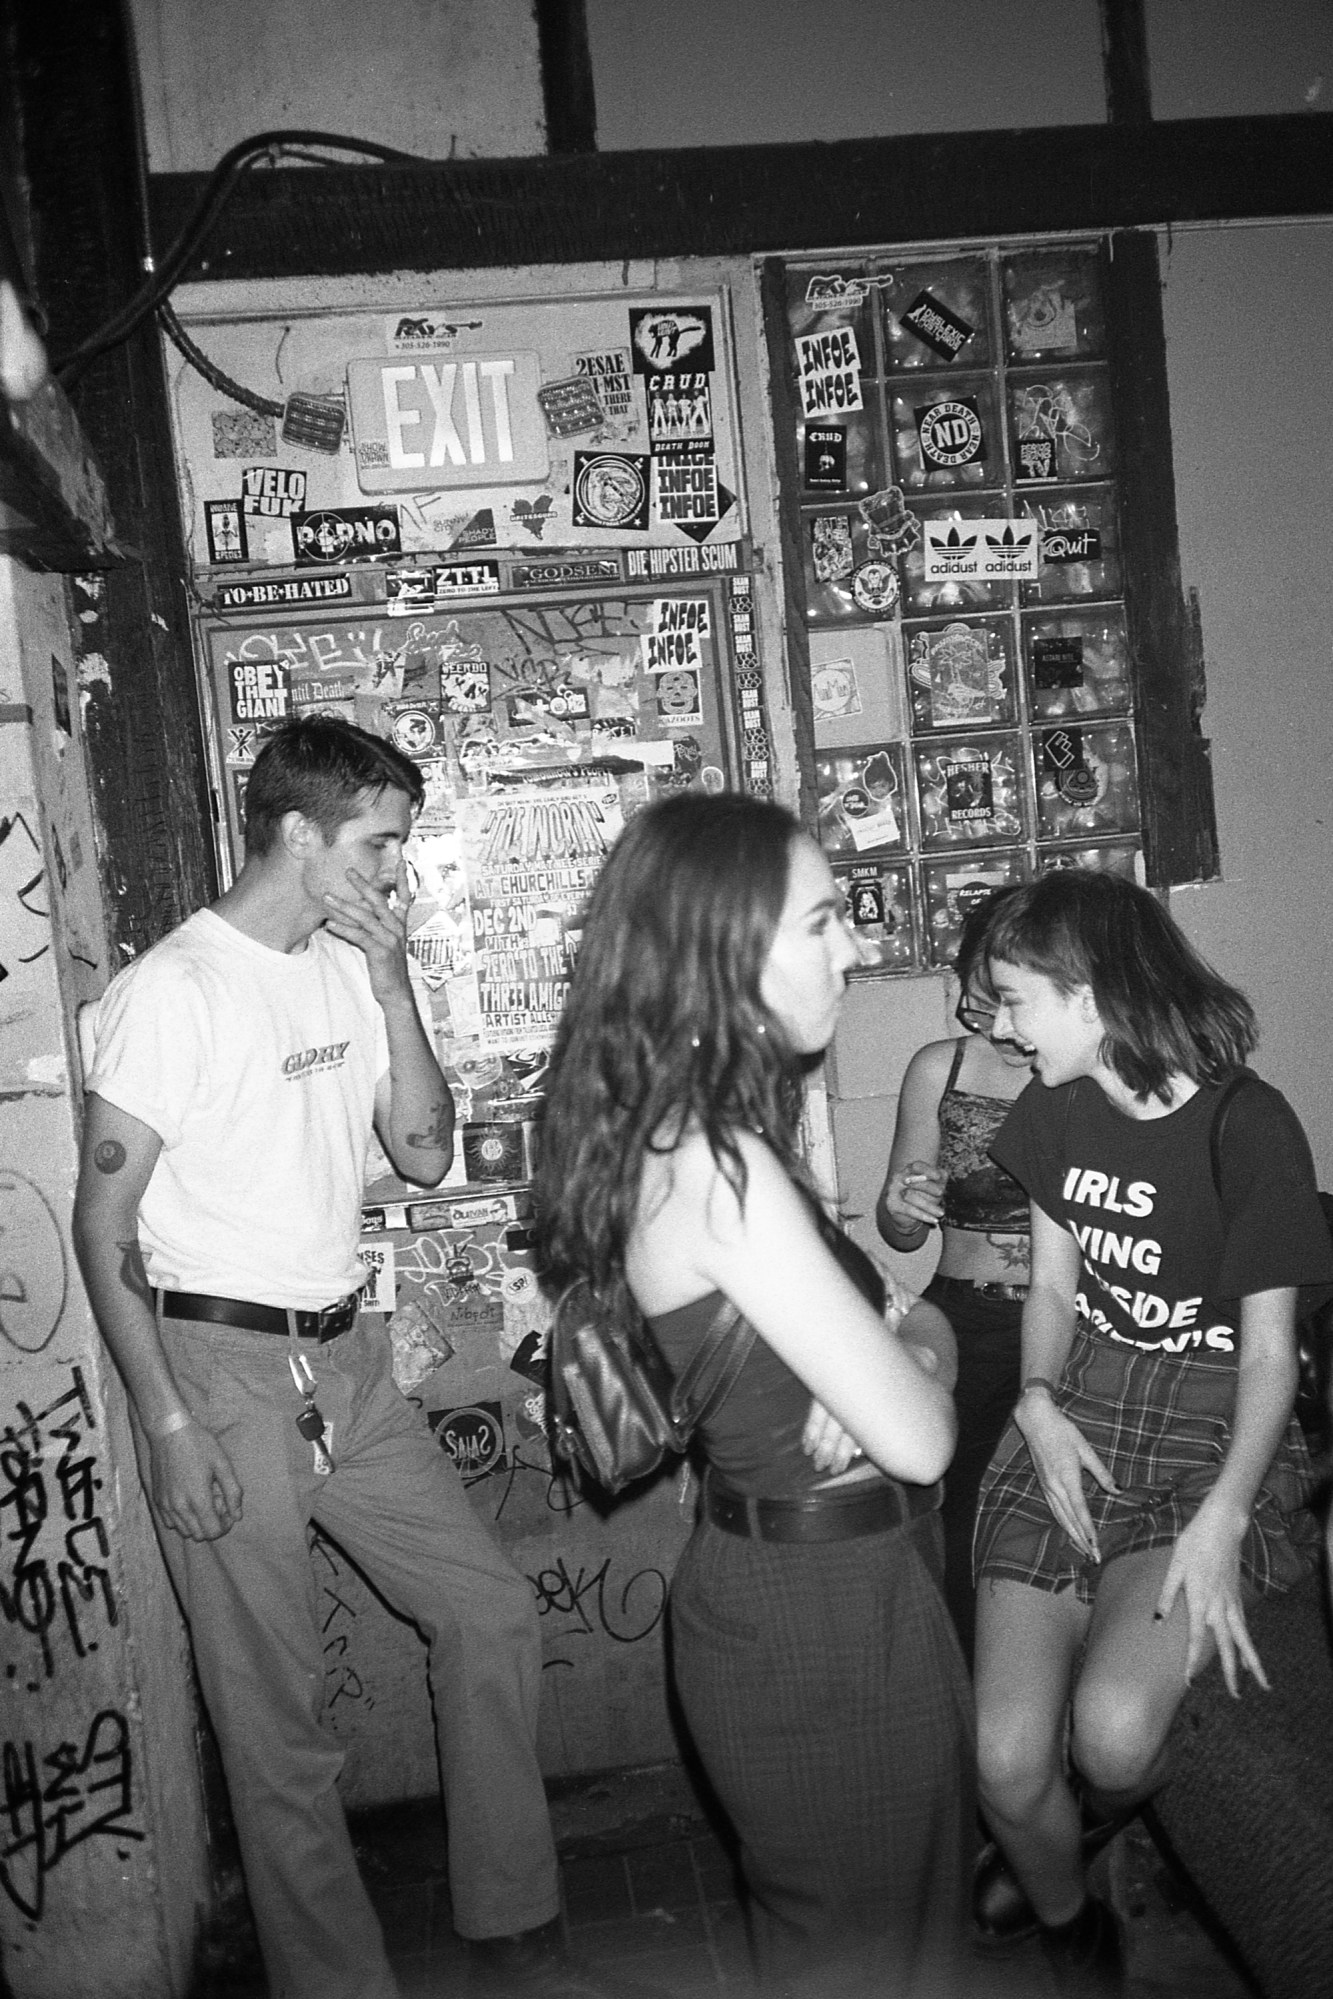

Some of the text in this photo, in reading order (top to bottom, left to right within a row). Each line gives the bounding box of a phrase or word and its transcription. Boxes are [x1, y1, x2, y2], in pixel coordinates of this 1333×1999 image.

[802, 332, 856, 376] INFOE
[649, 373, 706, 390] CRUD
[805, 372, 859, 413] INFOE
[381, 361, 514, 469] EXIT
[922, 405, 976, 434] NEAR DEATH
[934, 419, 968, 448] ND
[925, 434, 980, 463] NEAR DEATH
[247, 469, 305, 499] VELO
[658, 469, 714, 493] INFOE
[244, 494, 303, 517] FUK
[660, 494, 716, 519] INFOE
[1043, 532, 1097, 557] Quit
[627, 544, 737, 575] DIE HIPSTER SCUM
[930, 560, 1032, 574] adidust adidust
[284, 578, 349, 599] HATED
[658, 602, 708, 633] INFOE
[648, 632, 697, 669] INFOE
[234, 664, 284, 698] OBEY
[292, 681, 344, 702] ntil Death
[236, 688, 287, 719] GIANT
[951, 807, 991, 820] RECORDS
[501, 869, 586, 895] CHURCHILLS
[473, 907, 505, 936] DEC
[508, 905, 537, 933] 2ND
[1062, 1167, 1157, 1217] IRLS
